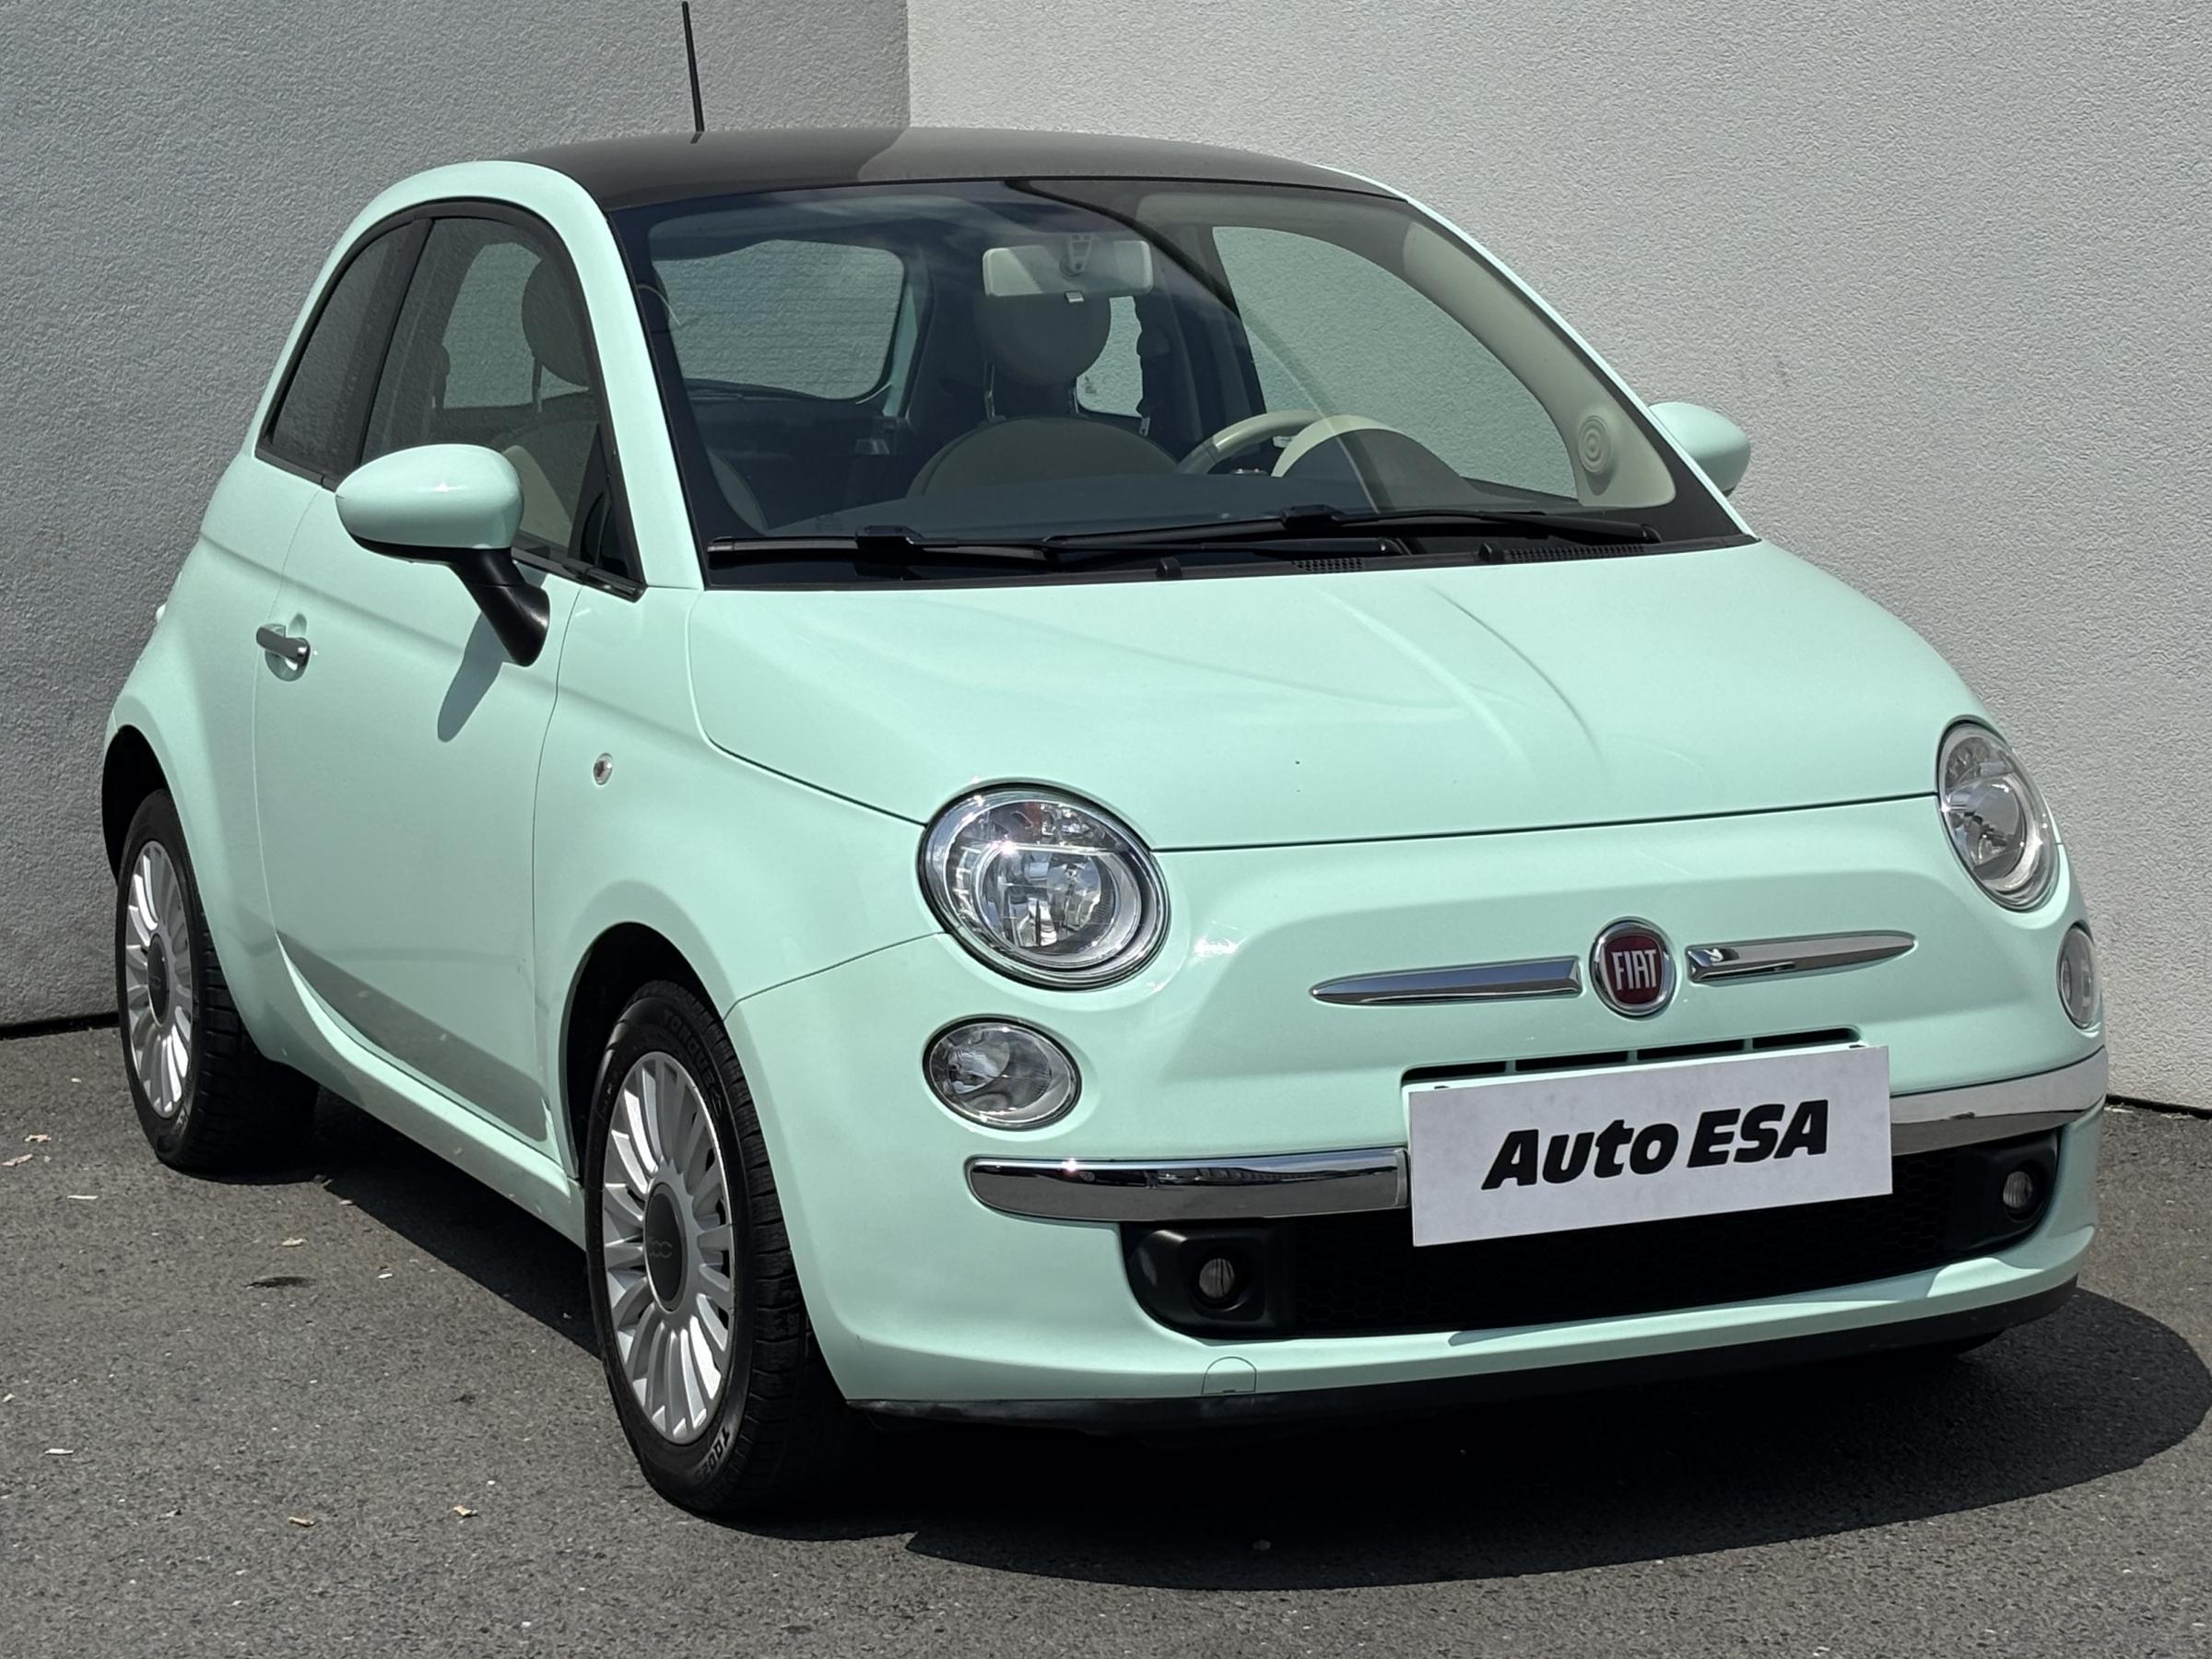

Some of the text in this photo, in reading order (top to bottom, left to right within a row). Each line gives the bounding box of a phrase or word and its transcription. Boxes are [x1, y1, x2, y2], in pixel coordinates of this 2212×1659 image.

[1611, 948, 1657, 991] FIAT
[1480, 1100, 1829, 1190] Auto ESA
